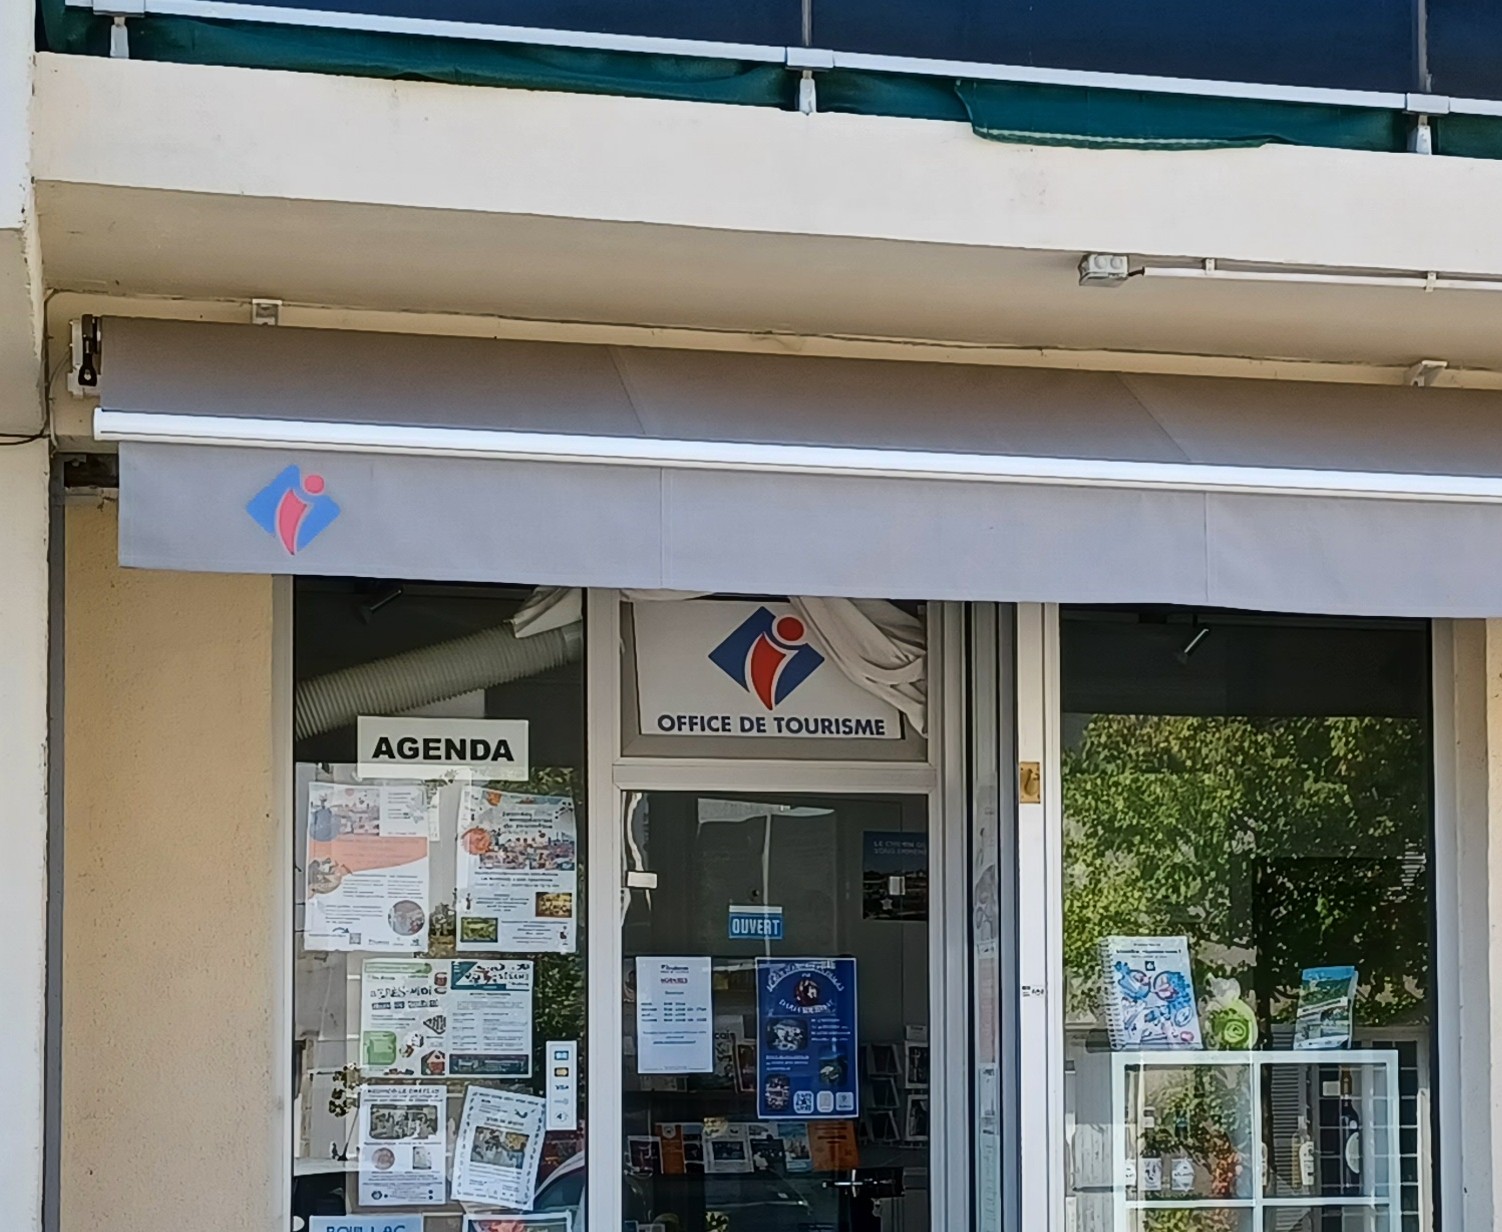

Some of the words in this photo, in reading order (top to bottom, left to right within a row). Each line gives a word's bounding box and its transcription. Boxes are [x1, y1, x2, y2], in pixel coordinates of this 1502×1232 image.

[657, 714, 731, 733] OFFICE
[739, 716, 767, 733] DE
[773, 716, 886, 736] TOURISME
[371, 736, 515, 762] AGENDA
[731, 917, 780, 935] OUVERT
